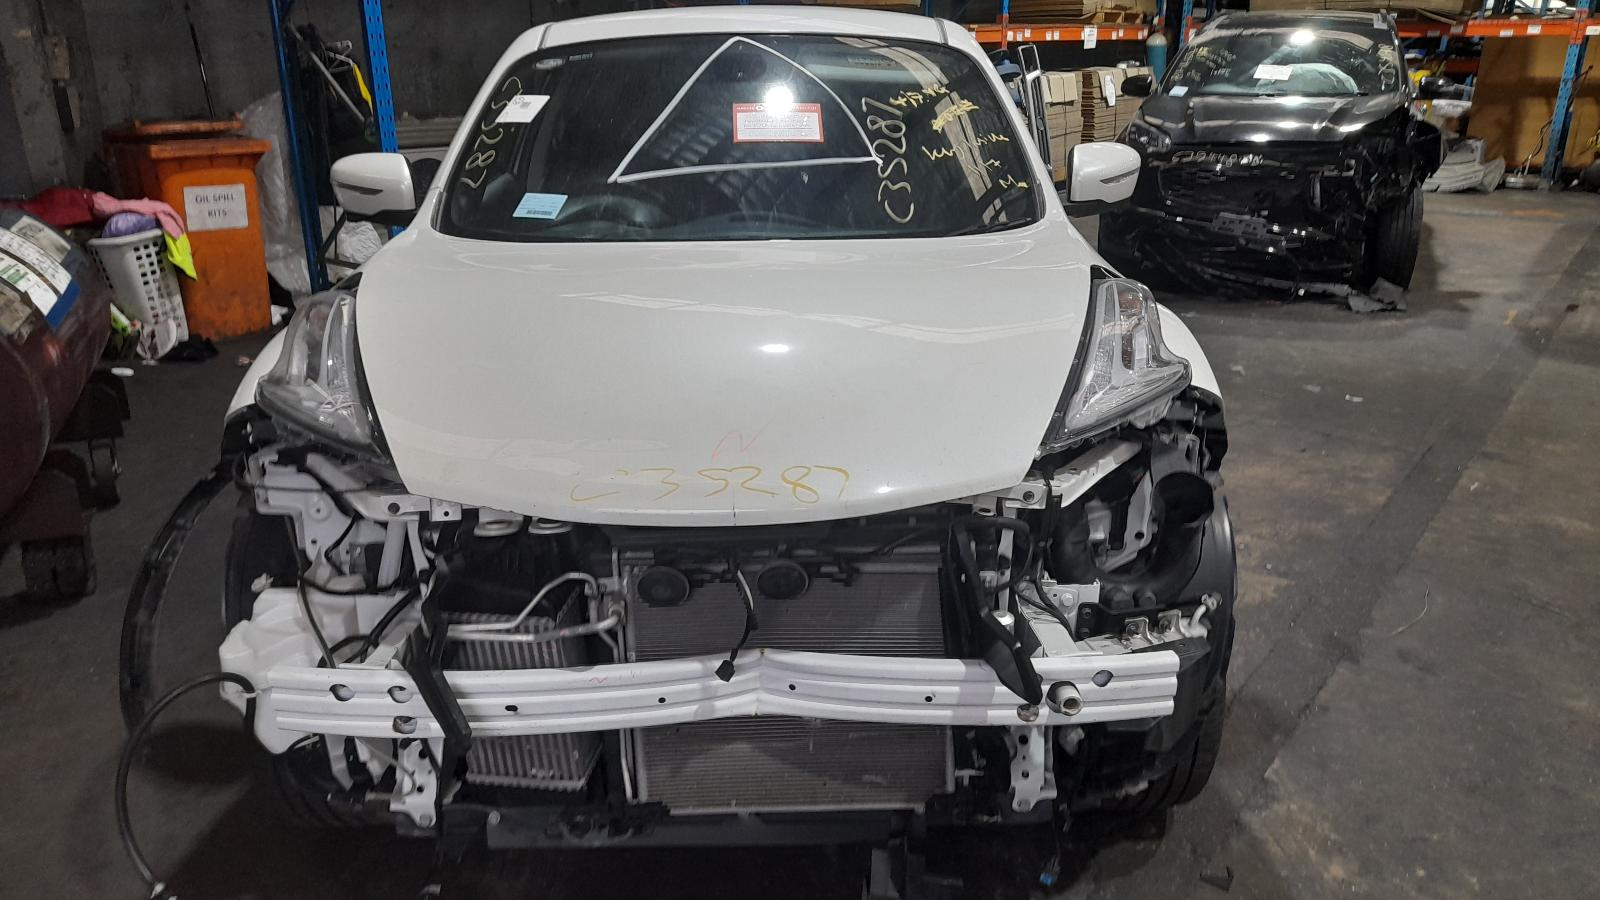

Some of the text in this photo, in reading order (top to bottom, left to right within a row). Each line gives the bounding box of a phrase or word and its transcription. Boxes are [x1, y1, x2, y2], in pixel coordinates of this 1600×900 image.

[861, 96, 915, 224] C35287
[194, 193, 235, 203] OIL SPILL
[207, 208, 228, 218] KITS
[569, 465, 850, 504] C35287
